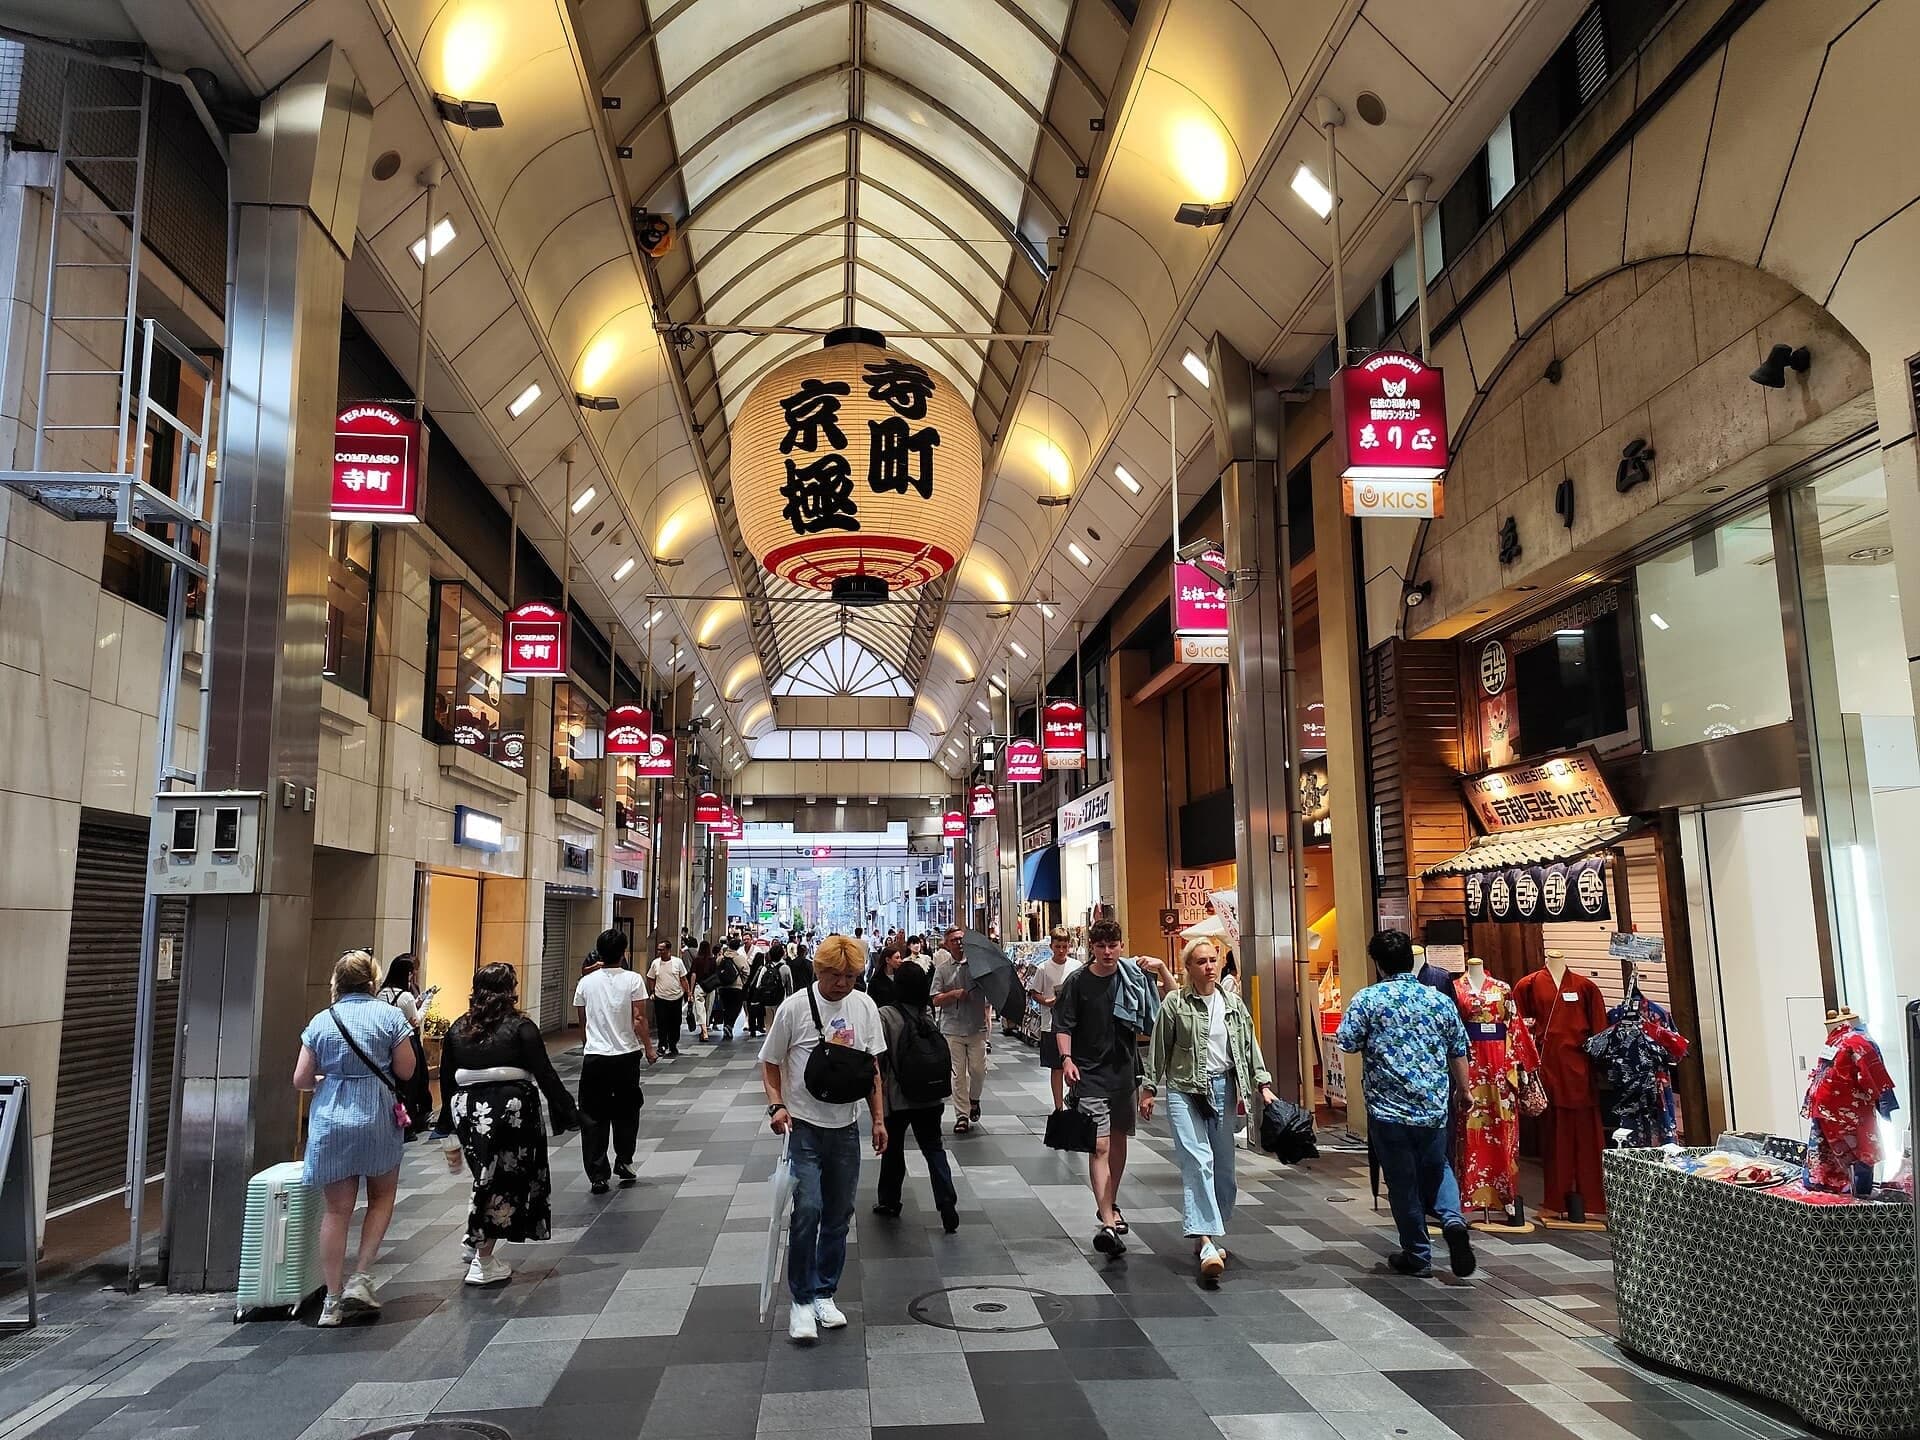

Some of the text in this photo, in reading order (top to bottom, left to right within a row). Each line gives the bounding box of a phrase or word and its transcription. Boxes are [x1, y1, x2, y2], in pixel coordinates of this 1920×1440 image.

[1365, 355, 1422, 374] TERAMACHI
[340, 408, 400, 426] TERAMACHI
[861, 357, 941, 500] 寺町
[335, 453, 400, 464] COMPASSO
[779, 377, 861, 536] 京極
[341, 468, 392, 492] 寺町
[1382, 491, 1428, 509] KICS
[518, 644, 551, 660] 寺町
[1471, 758, 1588, 794] KYOTO MAMESIBA CAFE
[1183, 908, 1208, 921] CAFE
